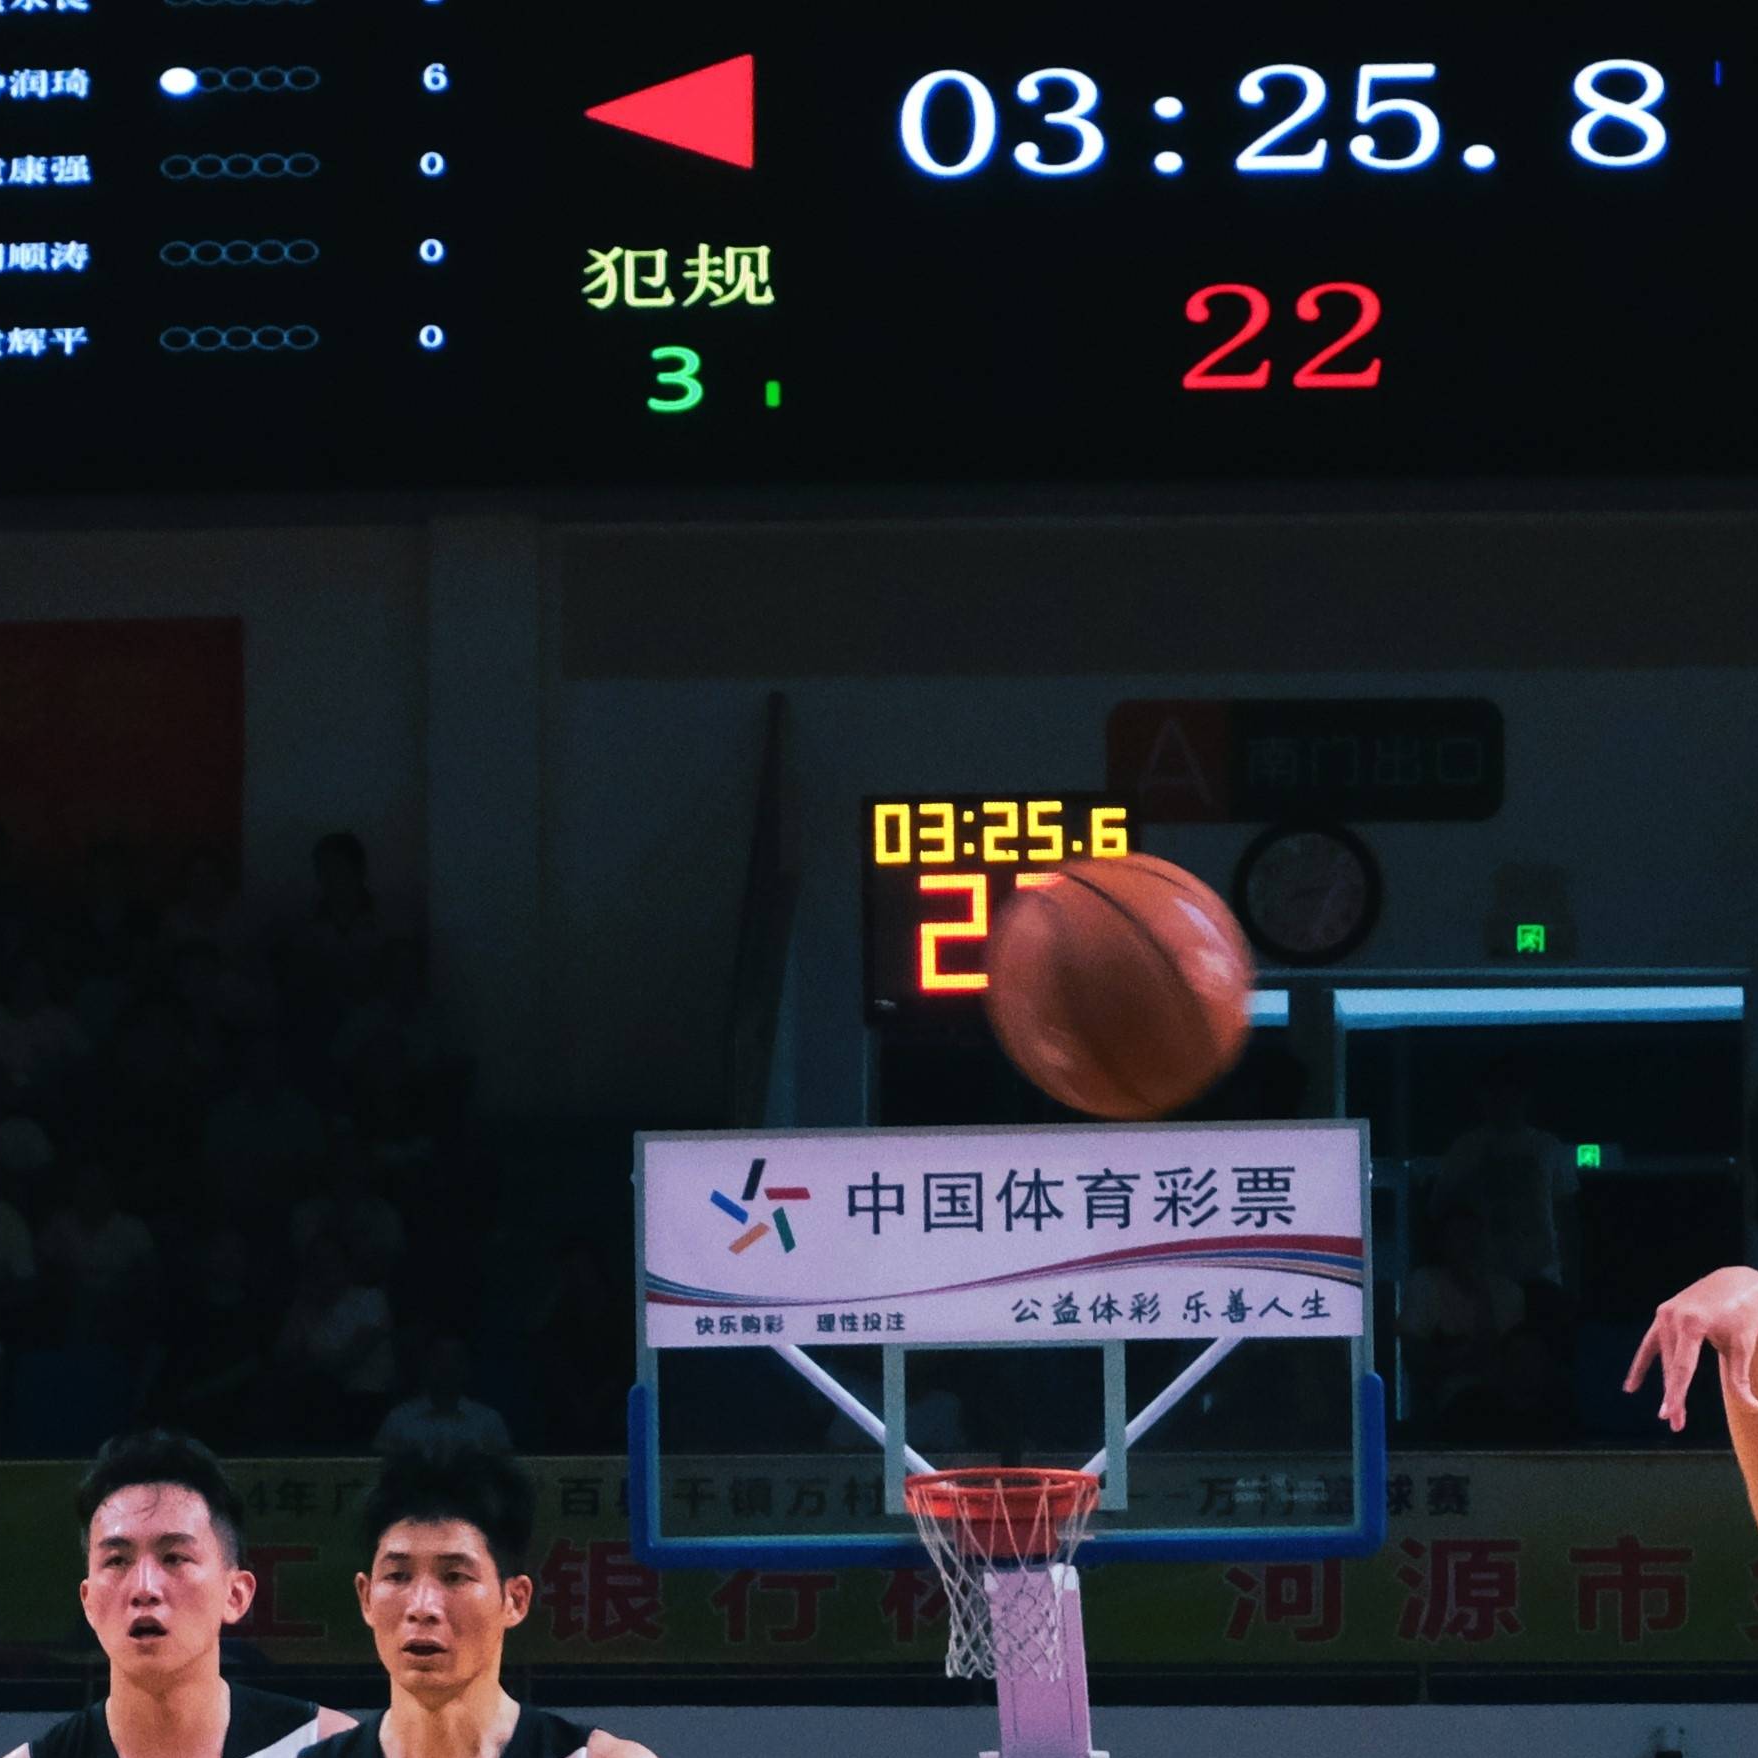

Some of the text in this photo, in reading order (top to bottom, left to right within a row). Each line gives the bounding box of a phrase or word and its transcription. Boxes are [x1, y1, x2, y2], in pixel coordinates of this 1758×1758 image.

[423, 63, 448, 92] 6
[898, 58, 1668, 178] 03:25.8
[420, 152, 446, 177] 0
[419, 239, 445, 264] 0
[582, 243, 774, 309] 犯规
[419, 325, 445, 350] 0
[1183, 282, 1381, 389] 22
[648, 346, 703, 412] 3
[874, 801, 1128, 864] 03:25.6
[847, 1166, 1297, 1234] 中国体育彩票
[695, 1311, 905, 1335] 快乐购彩 理性投注
[1011, 1288, 1332, 1326] 公益体彩 乐善人生
